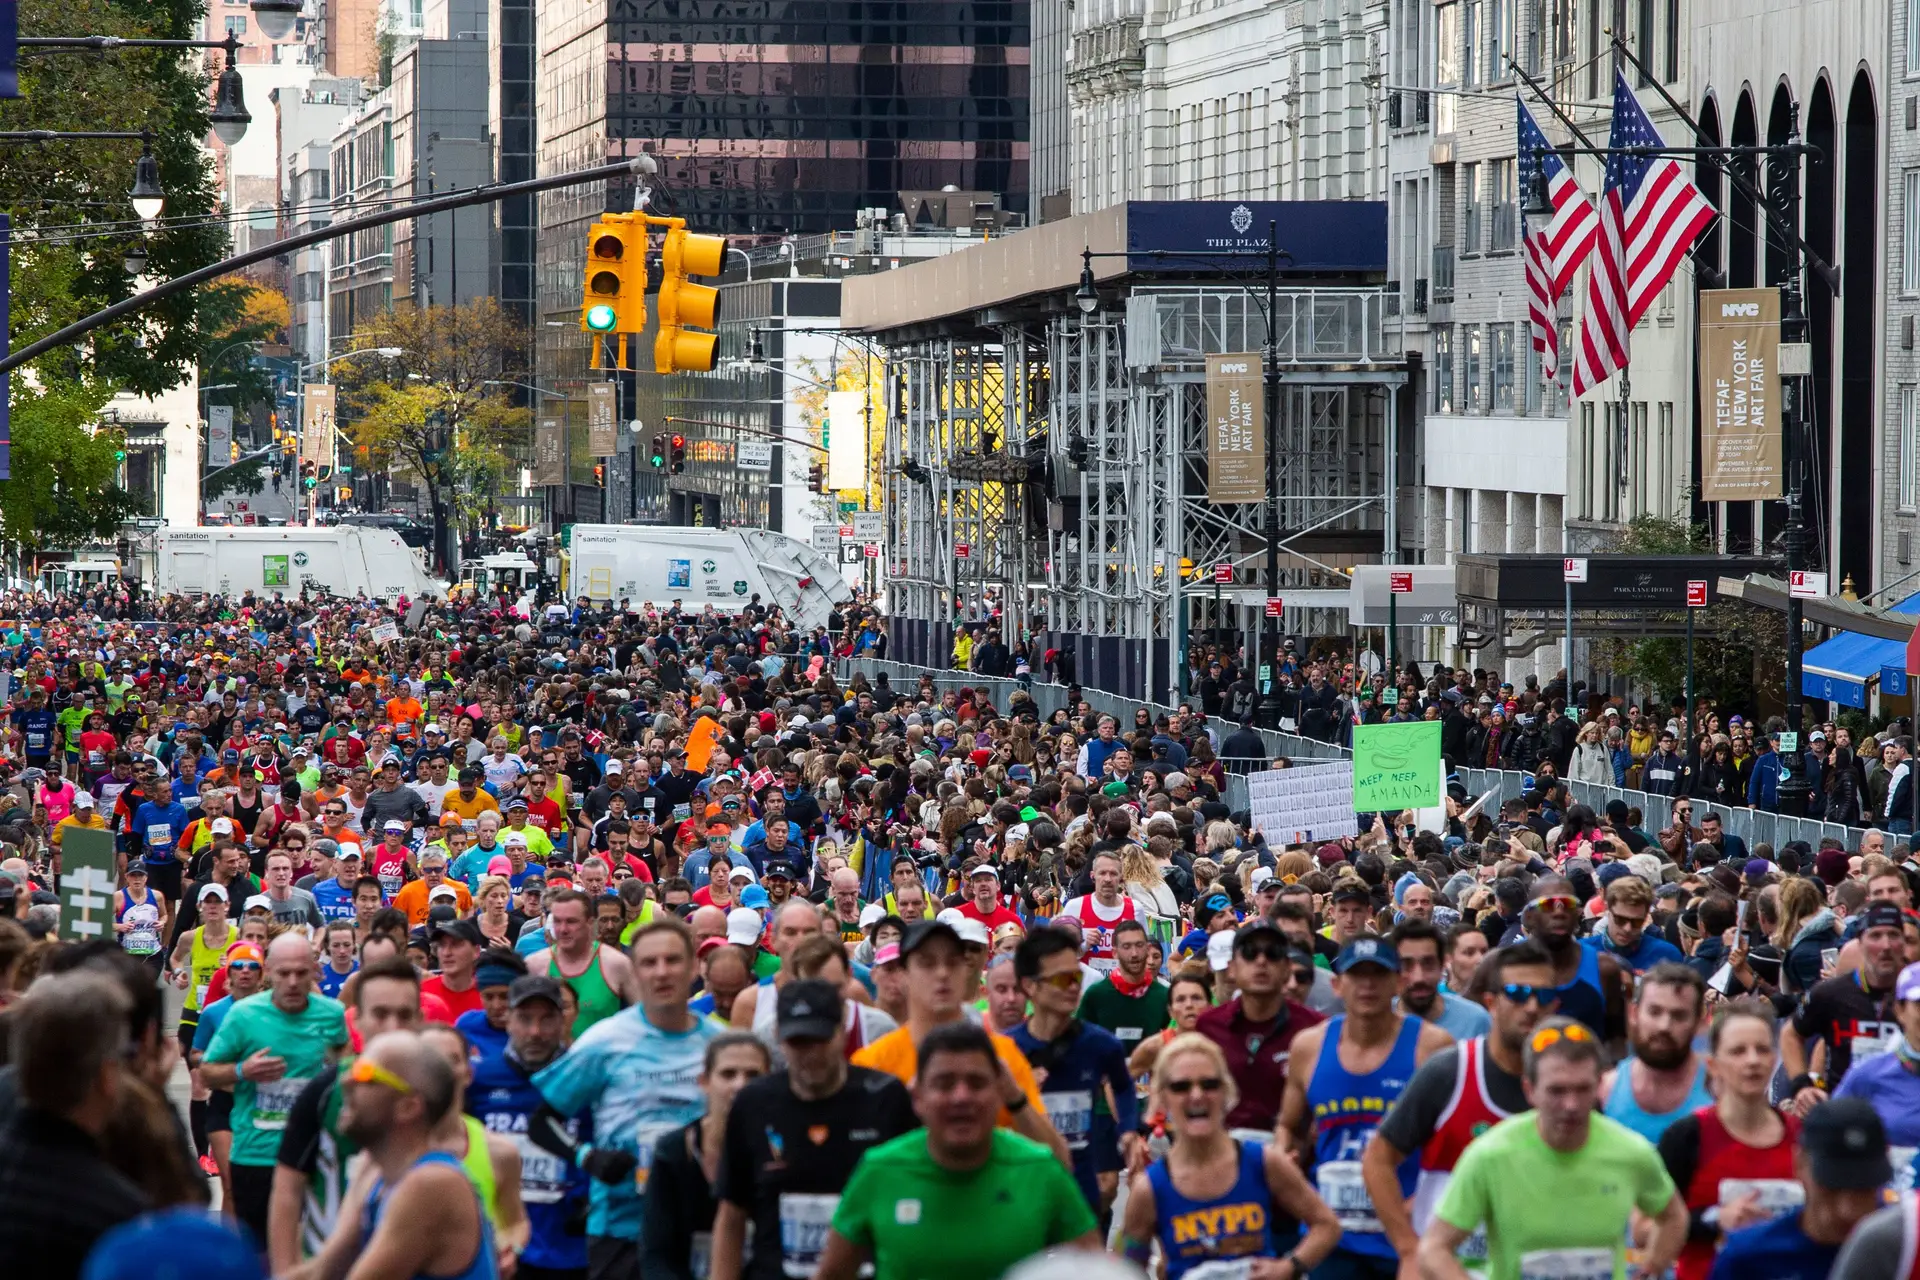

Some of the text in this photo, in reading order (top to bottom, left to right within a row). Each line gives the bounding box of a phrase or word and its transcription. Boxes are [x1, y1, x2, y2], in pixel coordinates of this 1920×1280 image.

[1206, 239, 1268, 247] THE PLAZ
[1722, 303, 1759, 317] NYC
[1221, 363, 1248, 374] NYC
[1733, 339, 1747, 427] NEW YORK
[1750, 357, 1765, 427] ART FAIR
[1716, 378, 1730, 429] TEFAF
[1229, 389, 1241, 451] NEW YORK
[1242, 401, 1253, 452] ART FAIR
[1218, 417, 1229, 452] TEFAF
[694, 503, 703, 527] PAR
[1420, 613, 1434, 622] 30
[546, 635, 561, 644] NYPD
[1360, 771, 1417, 787] MEEP MEEP
[1370, 783, 1439, 802] AMANDA!
[322, 906, 358, 917] ITAL
[1171, 1201, 1265, 1244] NYPD
